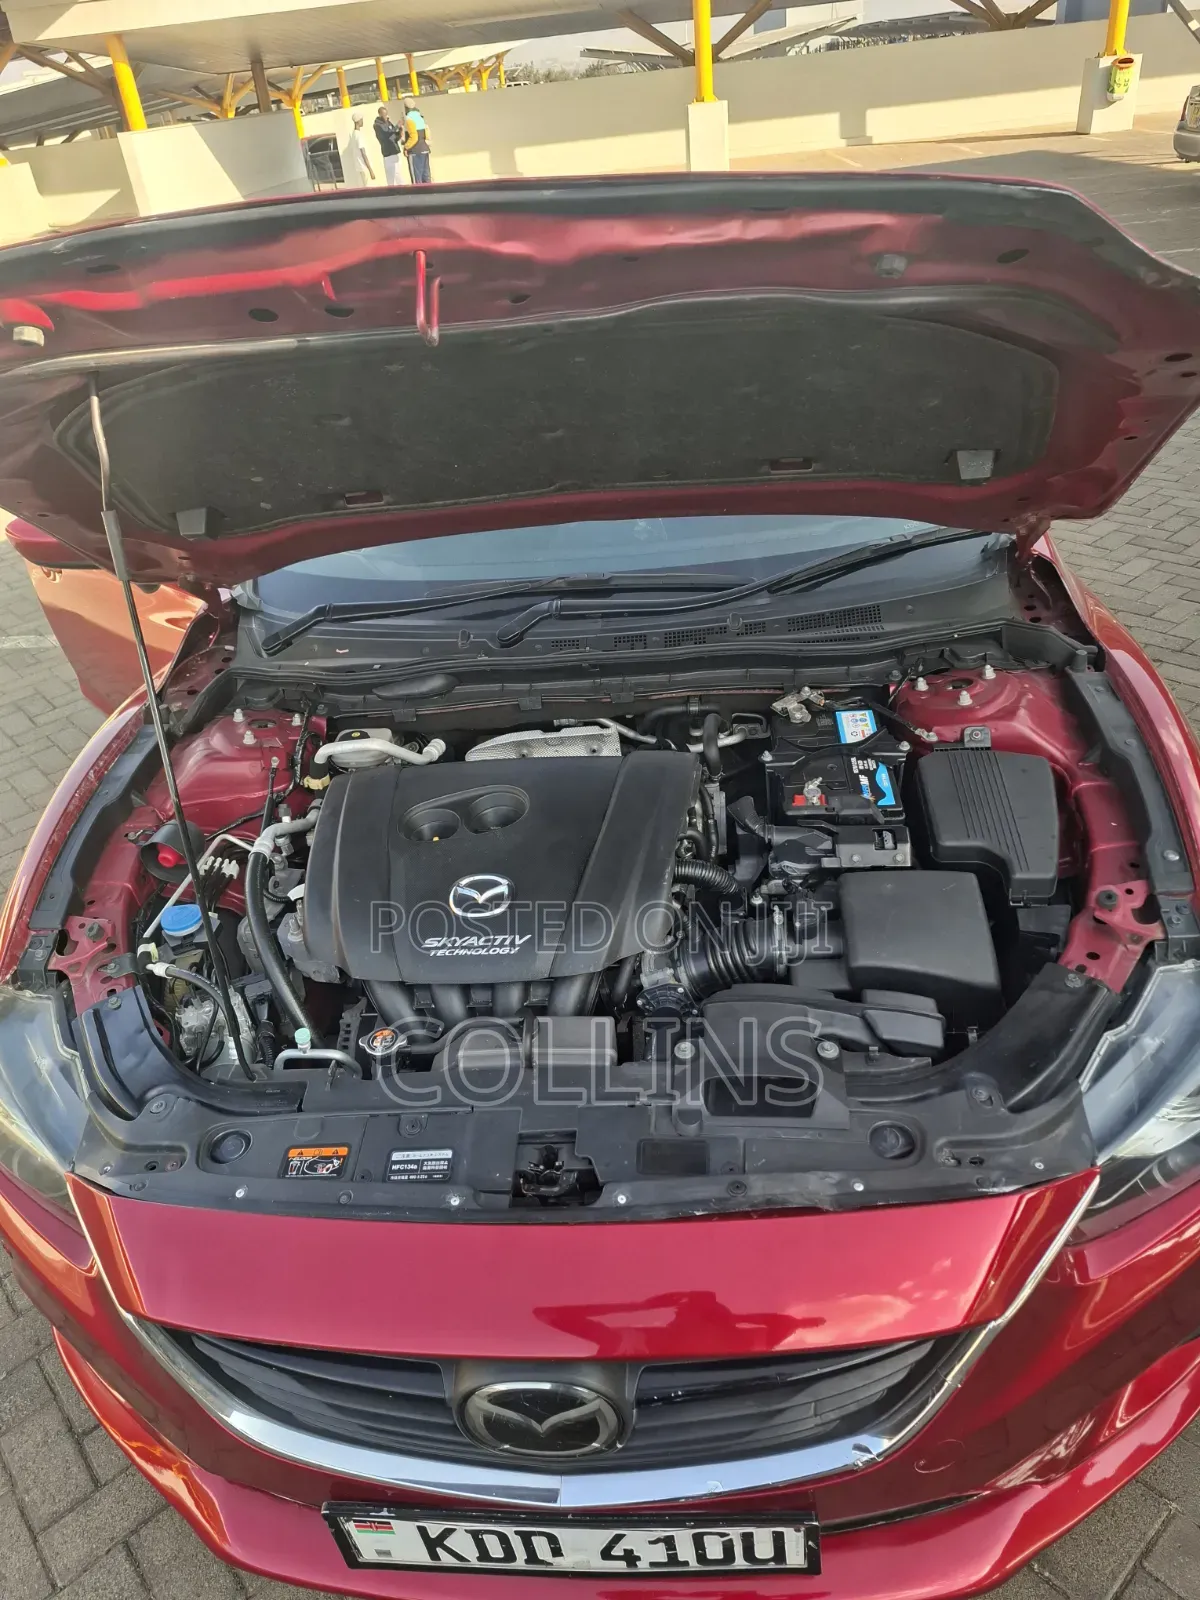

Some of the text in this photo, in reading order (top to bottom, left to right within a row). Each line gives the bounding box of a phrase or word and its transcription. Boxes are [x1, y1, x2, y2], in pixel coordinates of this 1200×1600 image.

[421, 934, 532, 948] SKYACTIV
[430, 946, 520, 957] TECHNOLOGY
[416, 1524, 565, 1567] KDD
[599, 1530, 787, 1568] 410U
